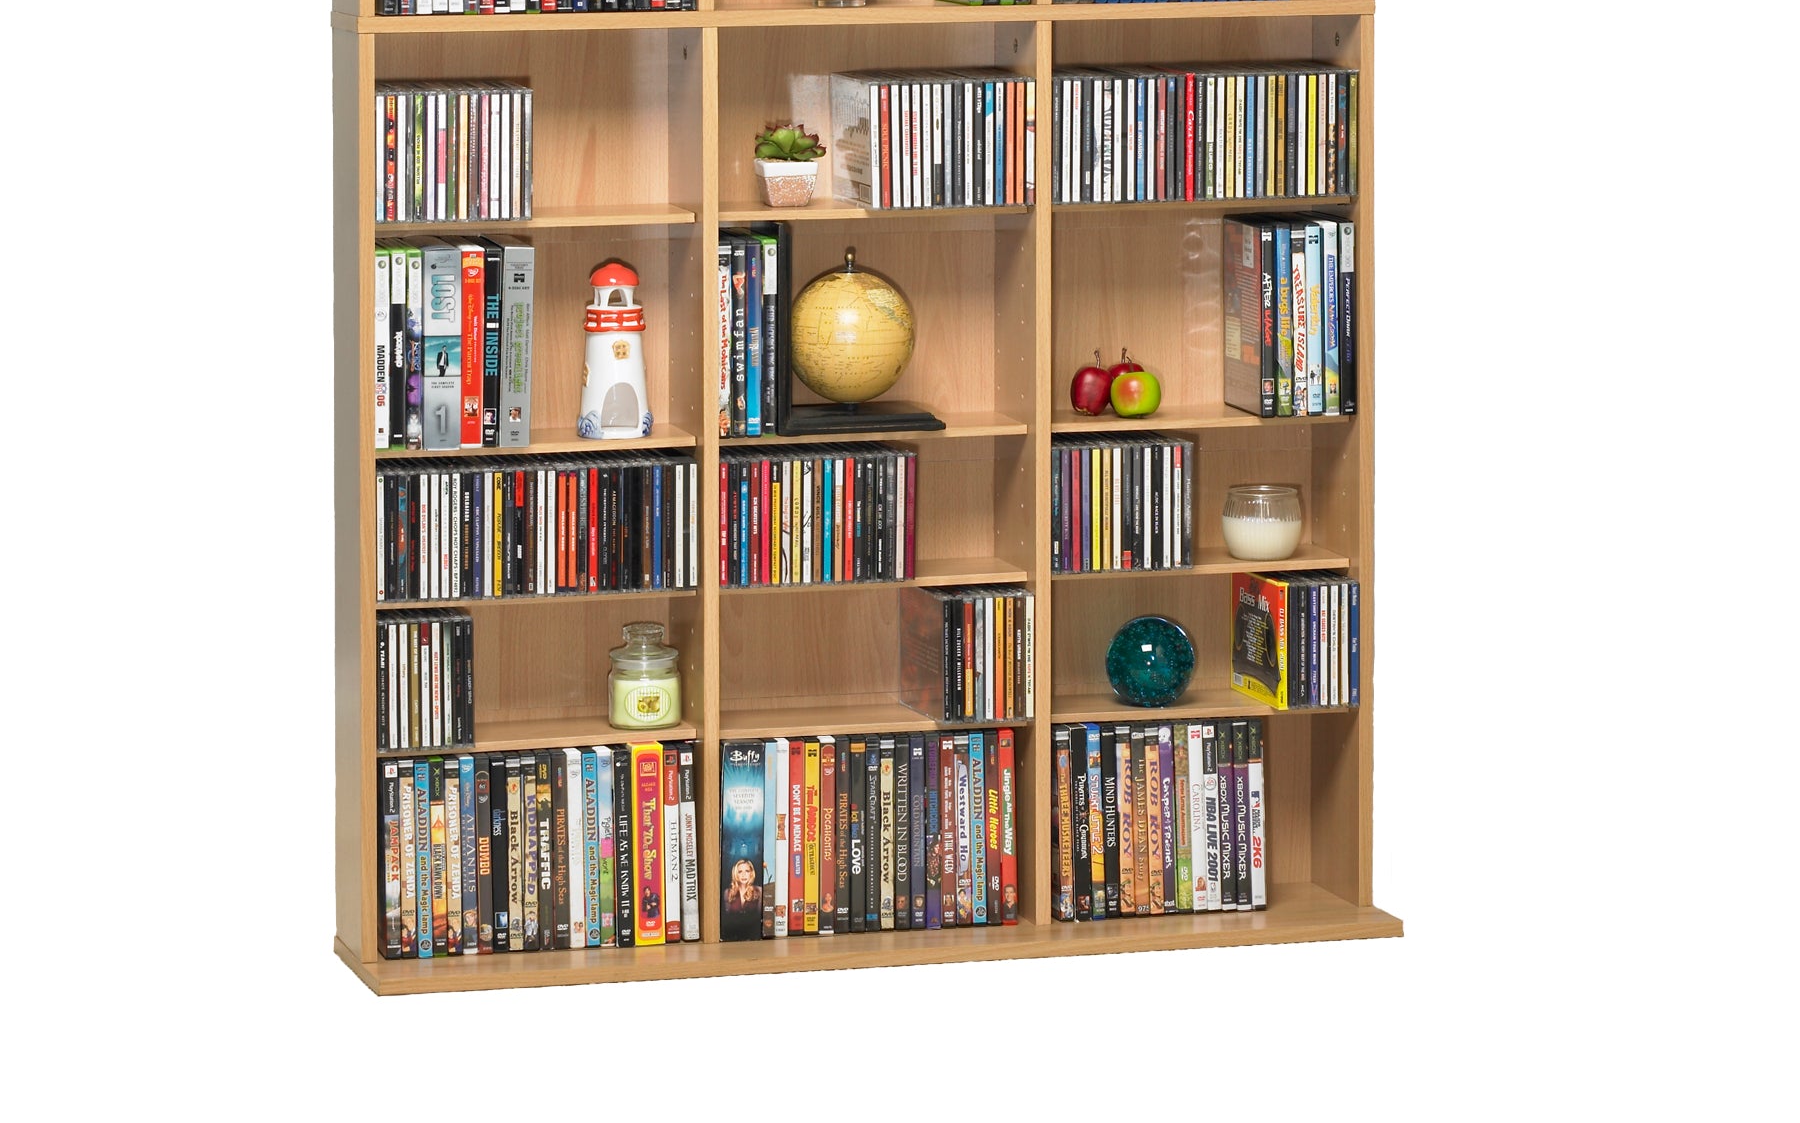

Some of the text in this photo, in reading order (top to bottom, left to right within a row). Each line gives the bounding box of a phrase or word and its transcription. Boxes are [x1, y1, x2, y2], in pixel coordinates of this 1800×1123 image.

[431, 274, 455, 323] LOST
[1293, 264, 1305, 372] TREASURE ISLAND
[486, 294, 499, 376] THE INSIDE
[721, 339, 729, 389] Mohicans
[734, 309, 744, 381] swimfan
[377, 346, 385, 406] MADDEN 06
[1240, 587, 1270, 613] Bass Mix
[792, 785, 800, 802] DON'T
[793, 805, 800, 814] BE
[1003, 768, 1012, 800] Jingle
[1106, 777, 1116, 847] MIND HUNTERS
[1136, 777, 1146, 816] JAMES
[1150, 761, 1160, 859] ROB ROY
[1192, 784, 1201, 831] CAROLINA
[449, 786, 460, 899] PRISONER OF ZENDA
[493, 809, 505, 835] darkness
[793, 824, 801, 852] MENACE
[824, 808, 832, 861] POCAHONTAS
[898, 763, 907, 881] WRITTEN IN BLOOD
[913, 795, 922, 867] COLD MOUNTAIN
[989, 789, 999, 849] Little Heroes
[1004, 827, 1013, 856] Way
[1091, 775, 1103, 854] STUART LITTLE 2
[1138, 820, 1146, 853] DEAN
[390, 820, 400, 881] JAMPACK
[467, 813, 476, 893] ATLANTIS
[479, 837, 490, 875] DUMBO
[510, 811, 519, 903] Black Arrow
[541, 818, 550, 890] TRAFFIC
[620, 815, 630, 908] LIFE AS WE KNOW IT
[1062, 821, 1070, 877] MUSKETEERS
[1137, 857, 1146, 881] Story
